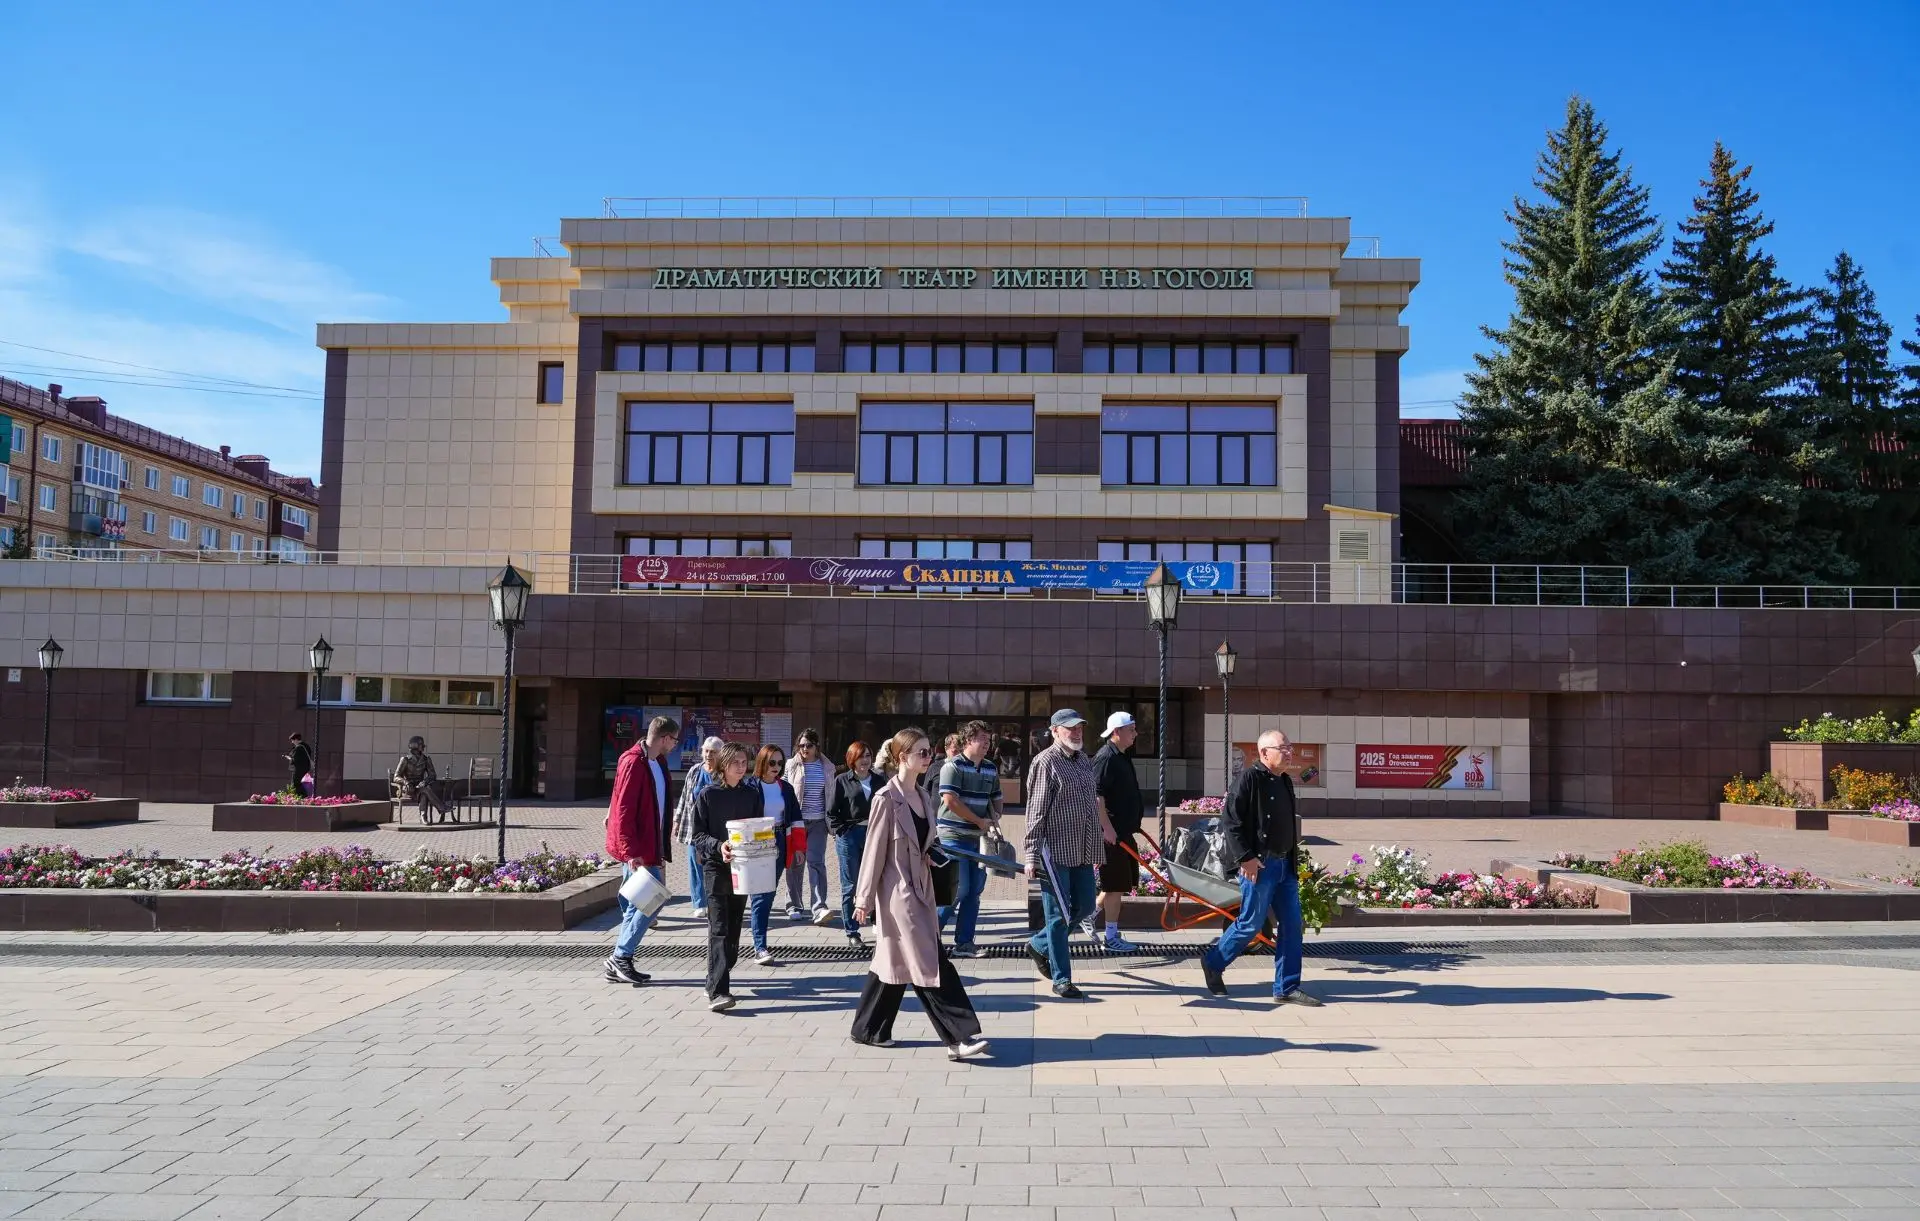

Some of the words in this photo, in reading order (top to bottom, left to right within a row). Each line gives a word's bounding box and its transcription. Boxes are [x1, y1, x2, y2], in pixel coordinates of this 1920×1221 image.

[653, 267, 883, 289] ДРАМАТИЧЕСКИЙ
[898, 268, 977, 288] ТЕАТР
[991, 268, 1089, 288] ИМЕНИ
[1100, 268, 1147, 288] Н.В.
[1152, 268, 1254, 288] ГОГОЛЯ
[645, 558, 661, 568] 126
[687, 560, 726, 570] Премьера
[1195, 563, 1211, 574] 126
[686, 571, 698, 580] 24
[707, 572, 718, 580] 25
[720, 572, 759, 583] октября,
[761, 572, 785, 581] 17.00
[809, 559, 896, 585] Плутни
[1360, 752, 1385, 766] 2025
[1388, 752, 1400, 761] Год
